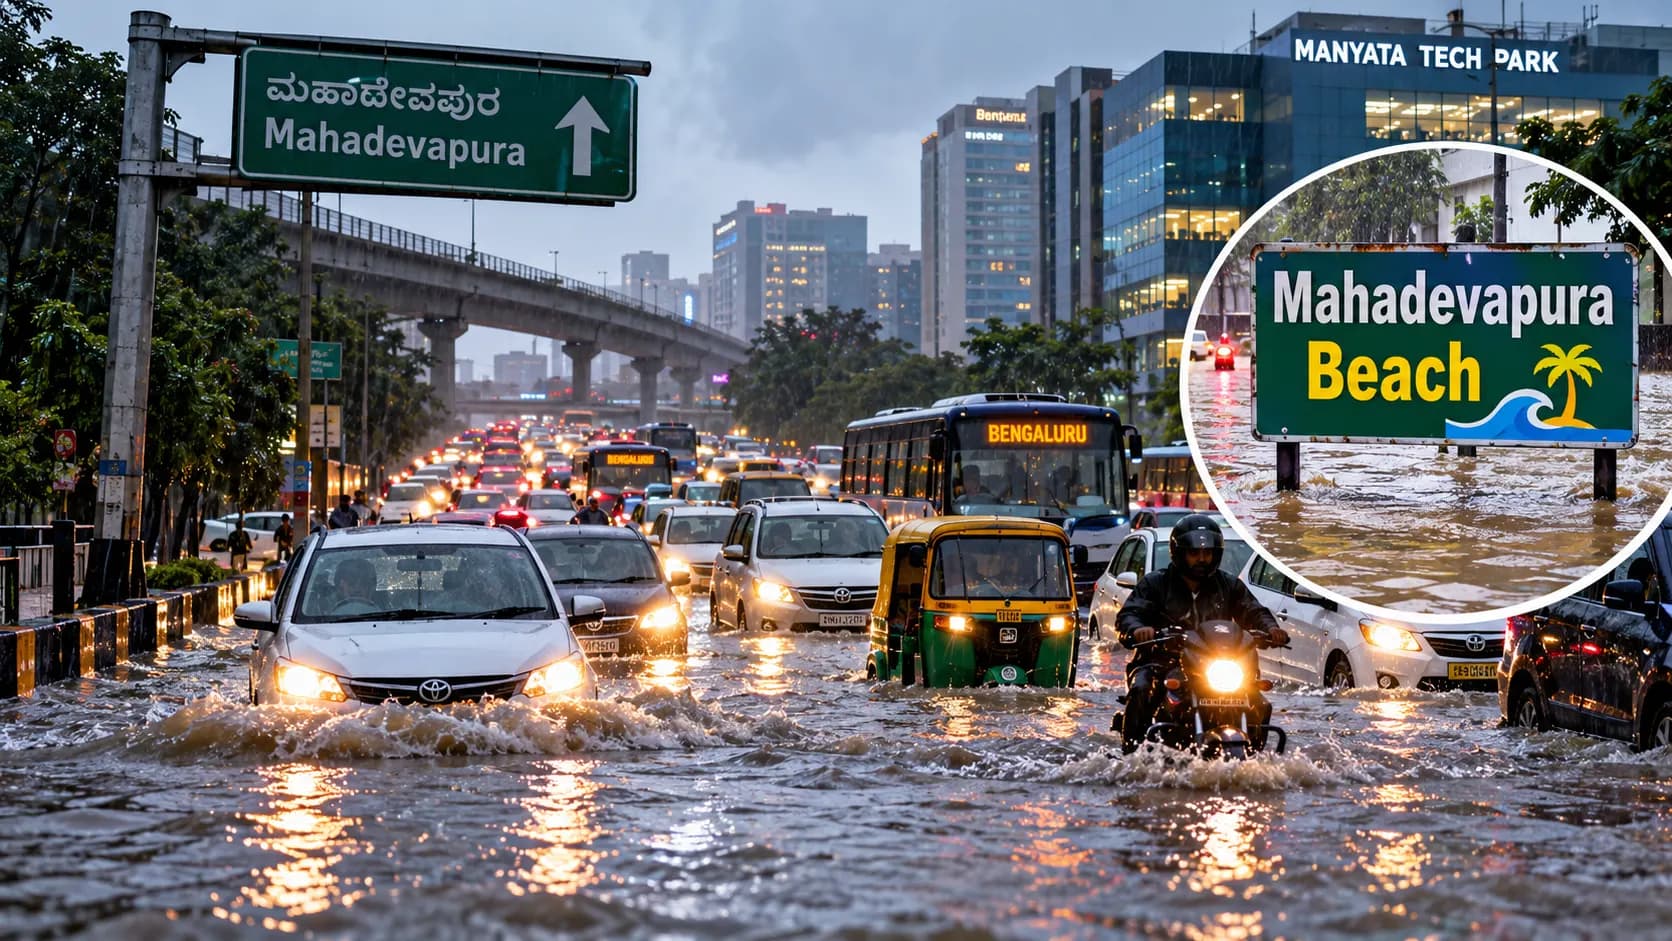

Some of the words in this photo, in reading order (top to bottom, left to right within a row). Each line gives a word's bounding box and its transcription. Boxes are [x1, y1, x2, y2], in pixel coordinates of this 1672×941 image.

[1294, 38, 1407, 66] MANYATA
[1418, 45, 1482, 70] TECH
[1494, 48, 1560, 73] PARK
[265, 117, 525, 168] Mahadevapura
[1273, 269, 1614, 338] Mahadevapura
[1307, 340, 1481, 402] Beach
[987, 423, 1087, 444] BENGALURU
